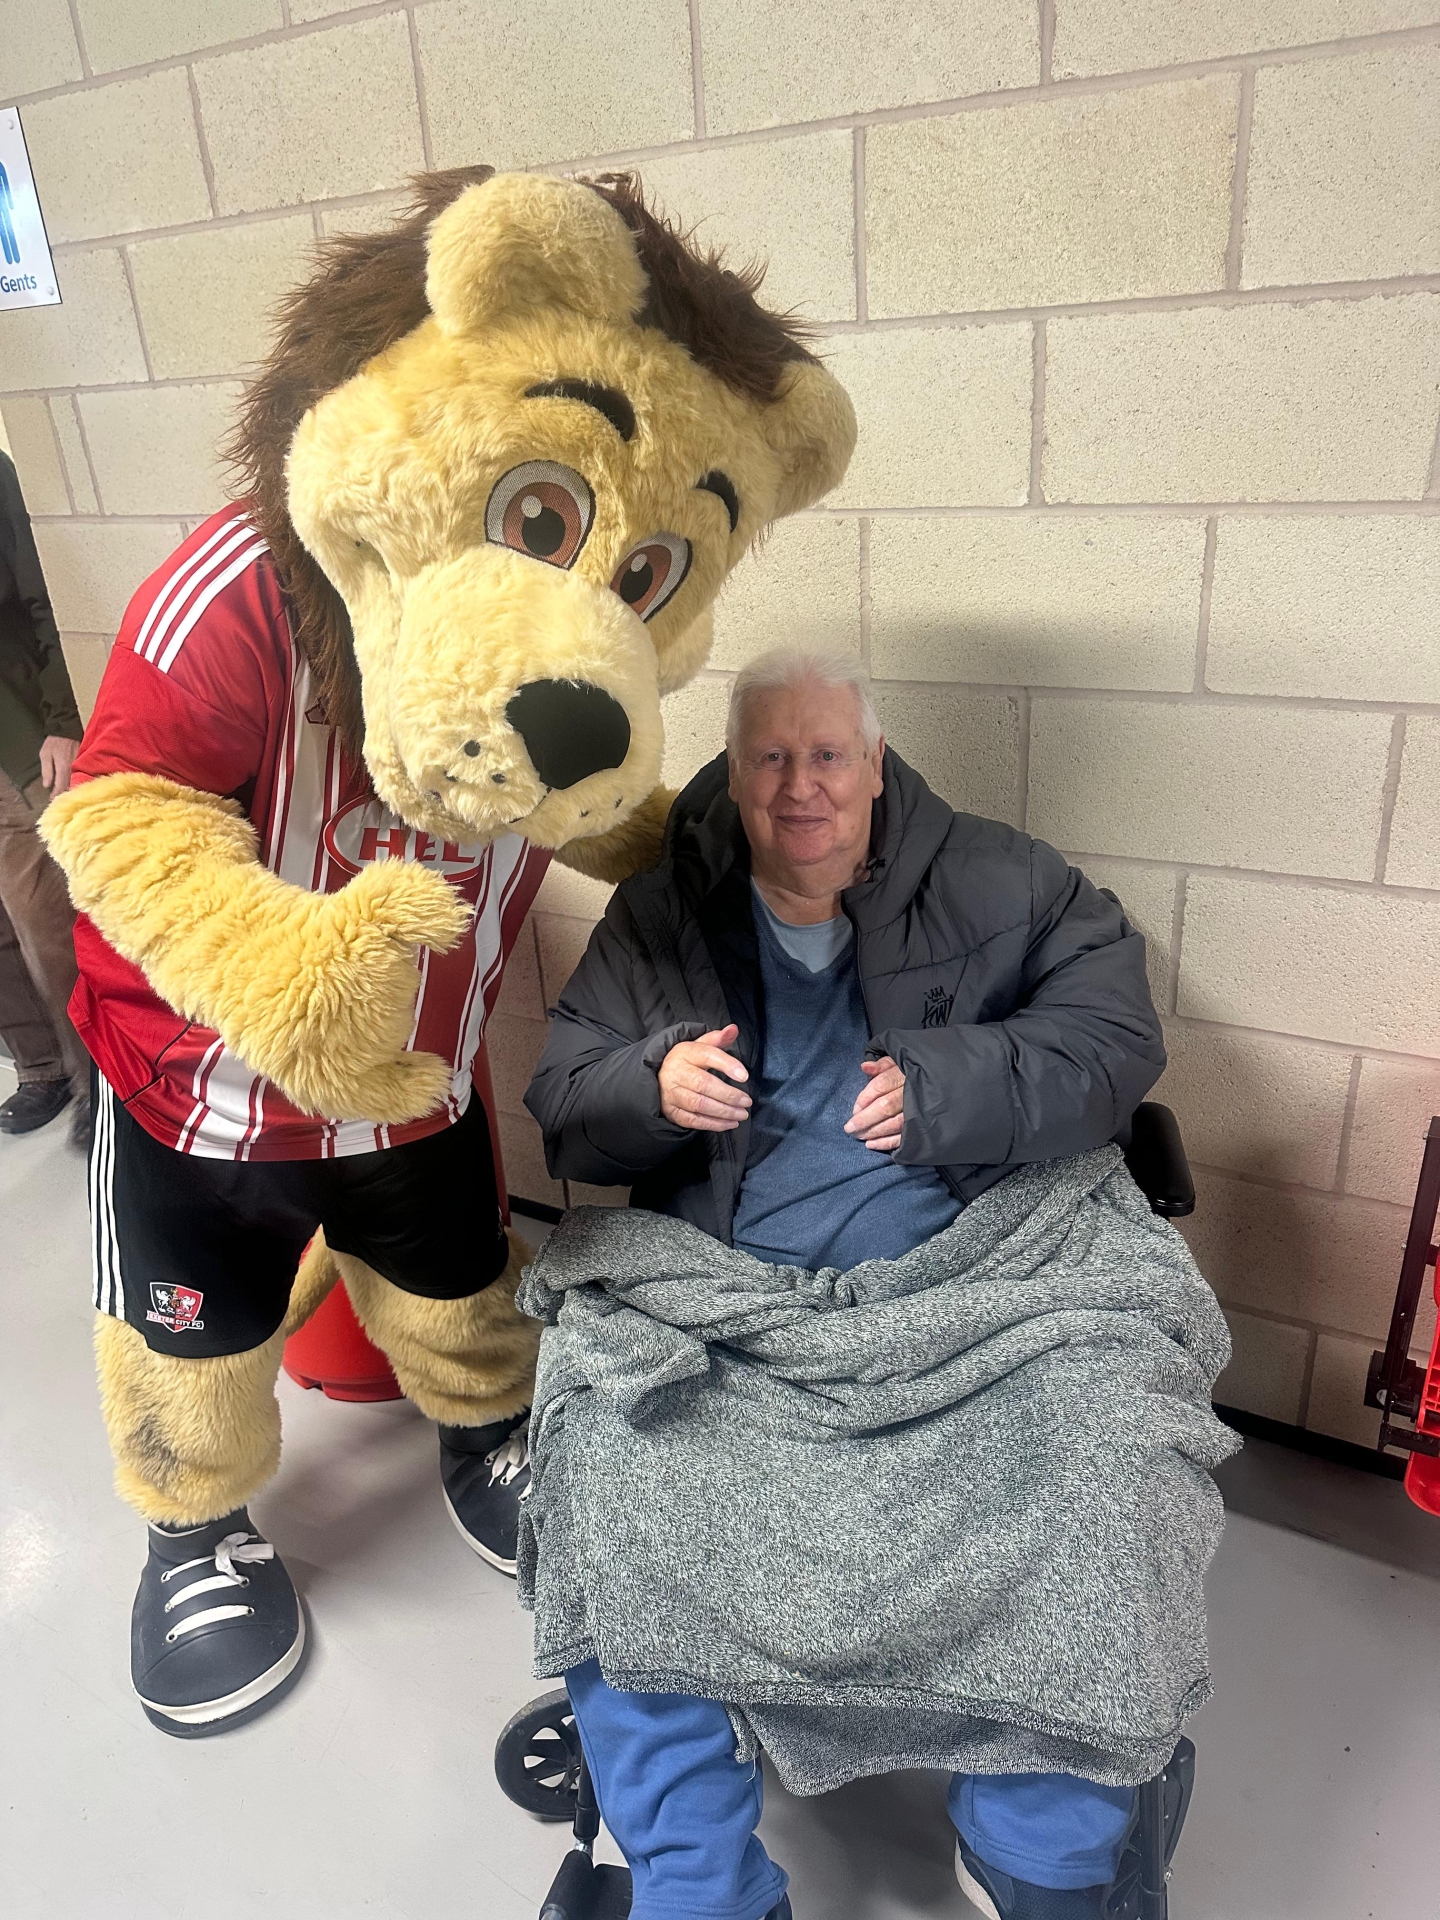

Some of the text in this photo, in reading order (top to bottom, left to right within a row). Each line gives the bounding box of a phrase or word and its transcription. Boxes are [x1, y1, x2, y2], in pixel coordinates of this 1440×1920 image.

[0, 274, 37, 293] Gents
[358, 827, 476, 863] HEL
[149, 1312, 176, 1325] EXETER
[175, 1319, 191, 1327] CITY
